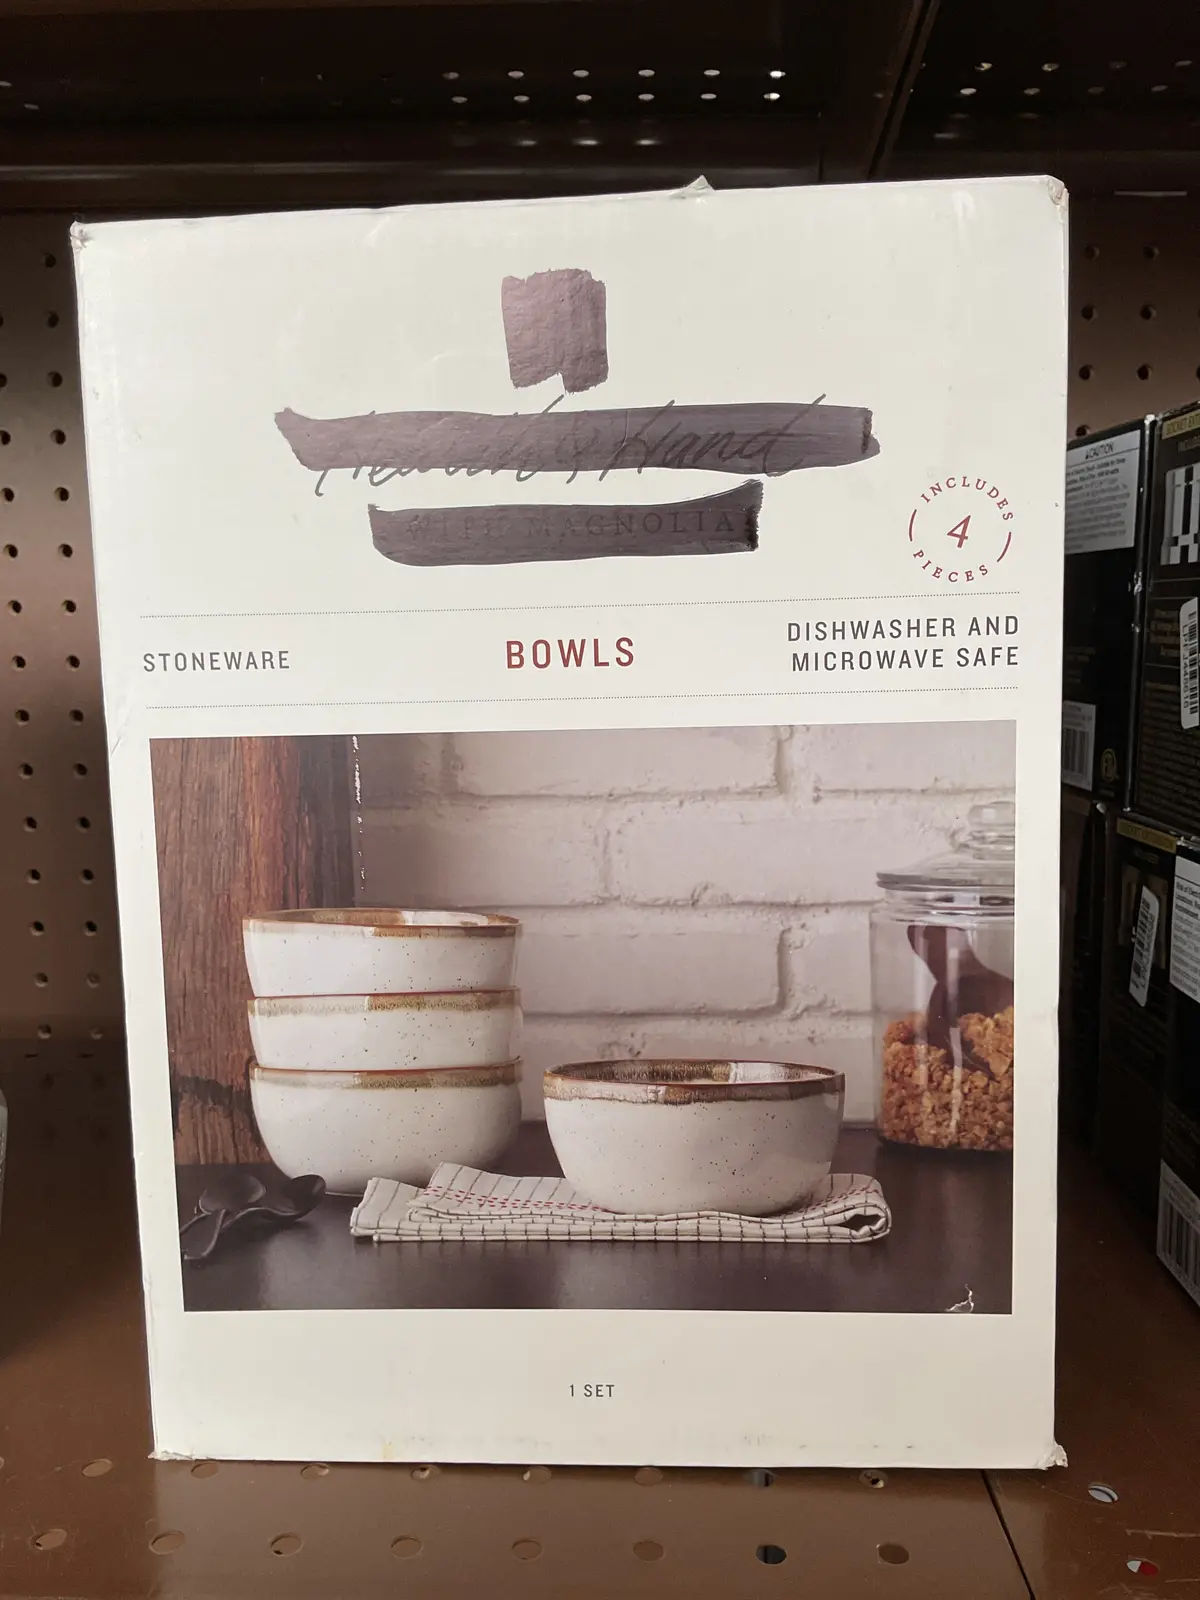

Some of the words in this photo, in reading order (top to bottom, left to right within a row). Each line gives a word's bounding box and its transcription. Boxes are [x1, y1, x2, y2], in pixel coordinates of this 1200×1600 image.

[599, 393, 826, 481] Hand
[920, 475, 1014, 522] INCLUDES
[526, 509, 737, 540] MAGNOLIA
[946, 514, 972, 549] 4
[912, 548, 989, 583] PIECES
[787, 617, 956, 642] DISHWASHER
[967, 615, 1019, 637] AND
[143, 650, 290, 673] STONEWARE
[506, 636, 635, 670] BOWLS
[792, 648, 944, 672] MICROWAVE
[956, 645, 1019, 668] SAFE
[569, 1383, 575, 1398] 1
[583, 1383, 615, 1398] SET
